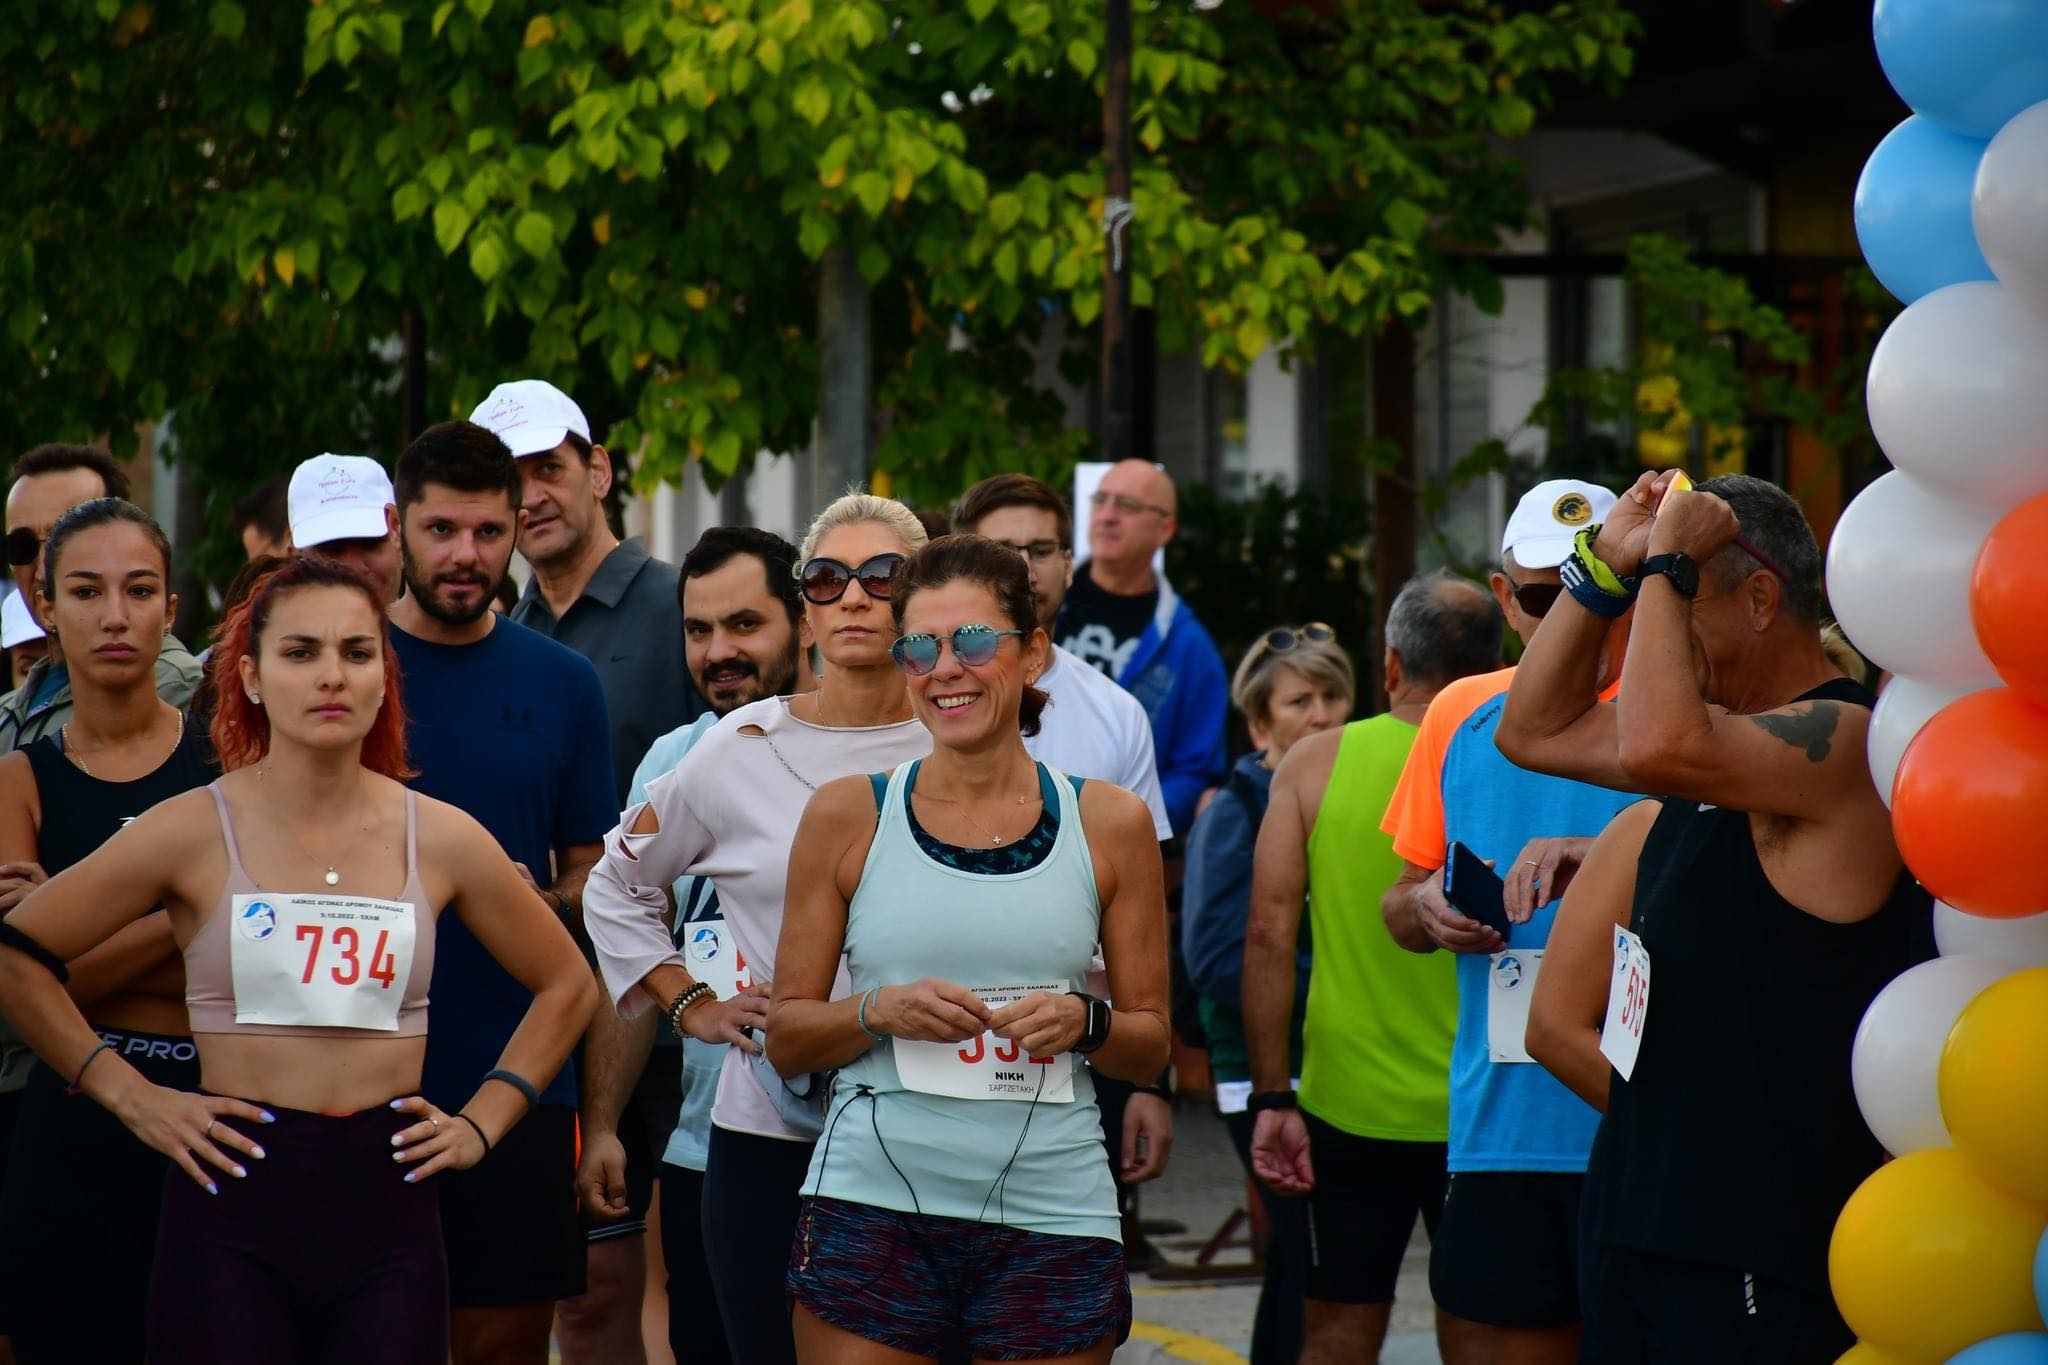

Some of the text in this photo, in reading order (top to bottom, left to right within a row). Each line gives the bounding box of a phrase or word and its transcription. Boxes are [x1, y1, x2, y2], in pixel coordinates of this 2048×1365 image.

[295, 925, 396, 989] 734
[124, 1038, 196, 1061] PRO
[995, 1071, 1025, 1081] ΝΙΚΗ
[988, 1084, 1035, 1094] ΣΑΡΤΖΕΤΑΚΗ
